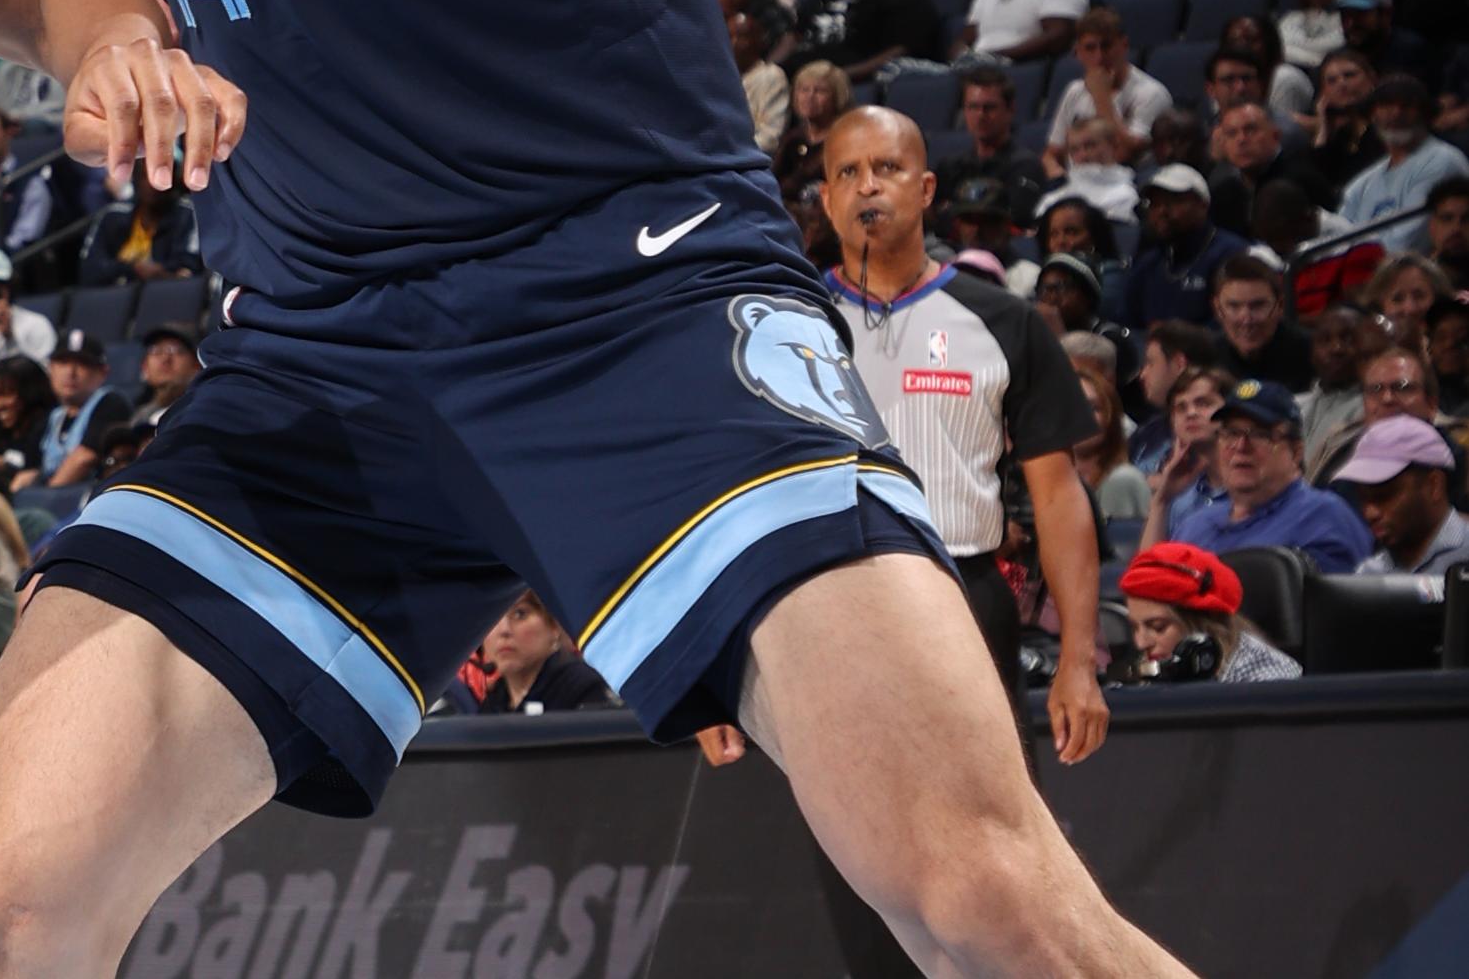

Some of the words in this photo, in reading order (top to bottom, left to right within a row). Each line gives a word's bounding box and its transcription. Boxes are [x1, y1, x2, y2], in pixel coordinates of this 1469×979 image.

[905, 372, 971, 394] Emirates
[121, 828, 415, 979] Bank
[414, 824, 691, 979] Easy
